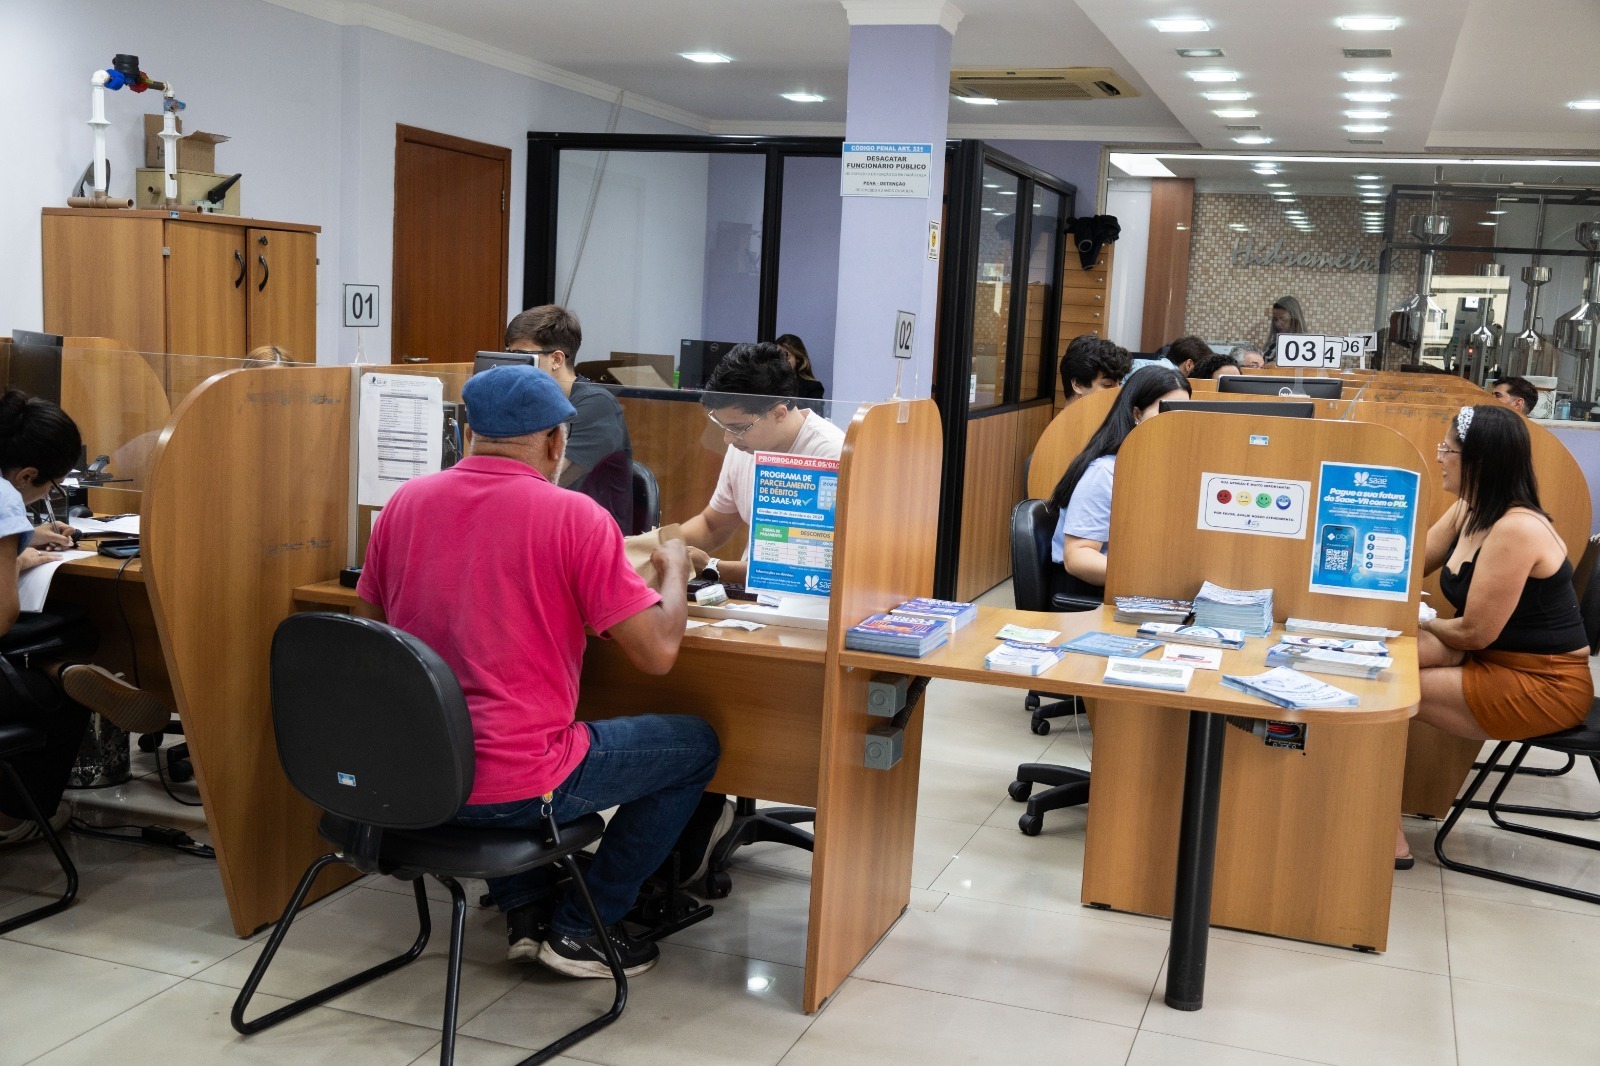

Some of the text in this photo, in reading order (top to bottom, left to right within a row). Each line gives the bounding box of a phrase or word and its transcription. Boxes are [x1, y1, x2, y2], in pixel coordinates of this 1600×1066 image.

[352, 292, 372, 319] 01
[900, 320, 911, 350] 02
[1285, 340, 1316, 362] 03
[758, 456, 803, 465] PRORROGADO
[760, 470, 801, 480] PROGRAMA
[760, 479, 816, 490] PARCELAMENTO
[770, 487, 798, 497] DÉBITOS
[1330, 488, 1356, 497] Pague
[1379, 492, 1405, 500] fatura
[771, 497, 802, 506] SAAE-VR
[1335, 496, 1369, 505] Saae-VR
